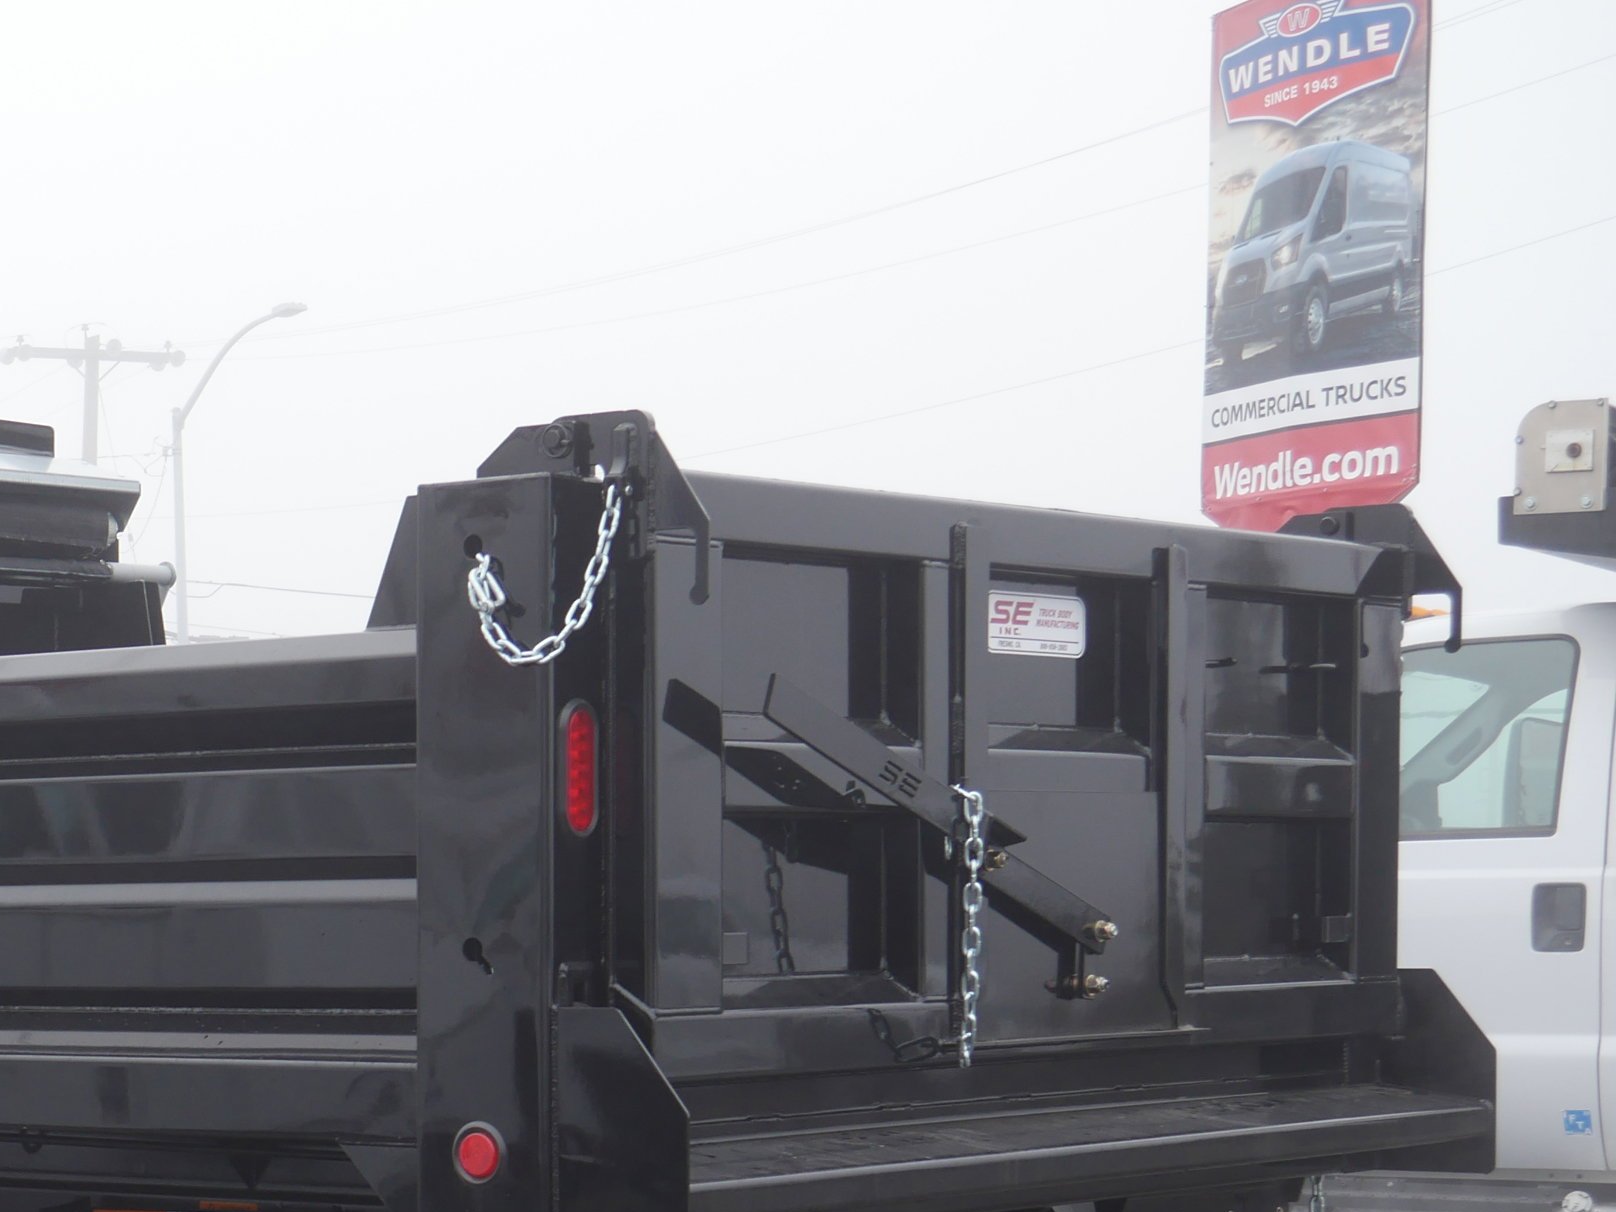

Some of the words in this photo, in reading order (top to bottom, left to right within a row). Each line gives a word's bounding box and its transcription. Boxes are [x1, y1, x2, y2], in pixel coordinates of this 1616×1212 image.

[1226, 22, 1392, 94] WENDLE
[1264, 85, 1298, 108] SINCE
[1303, 75, 1338, 95] 1943
[1211, 391, 1316, 429] COMMERCIAL
[1321, 375, 1408, 405] TRUCKS
[1213, 445, 1399, 499] Wendle.com
[990, 600, 1035, 626] SE
